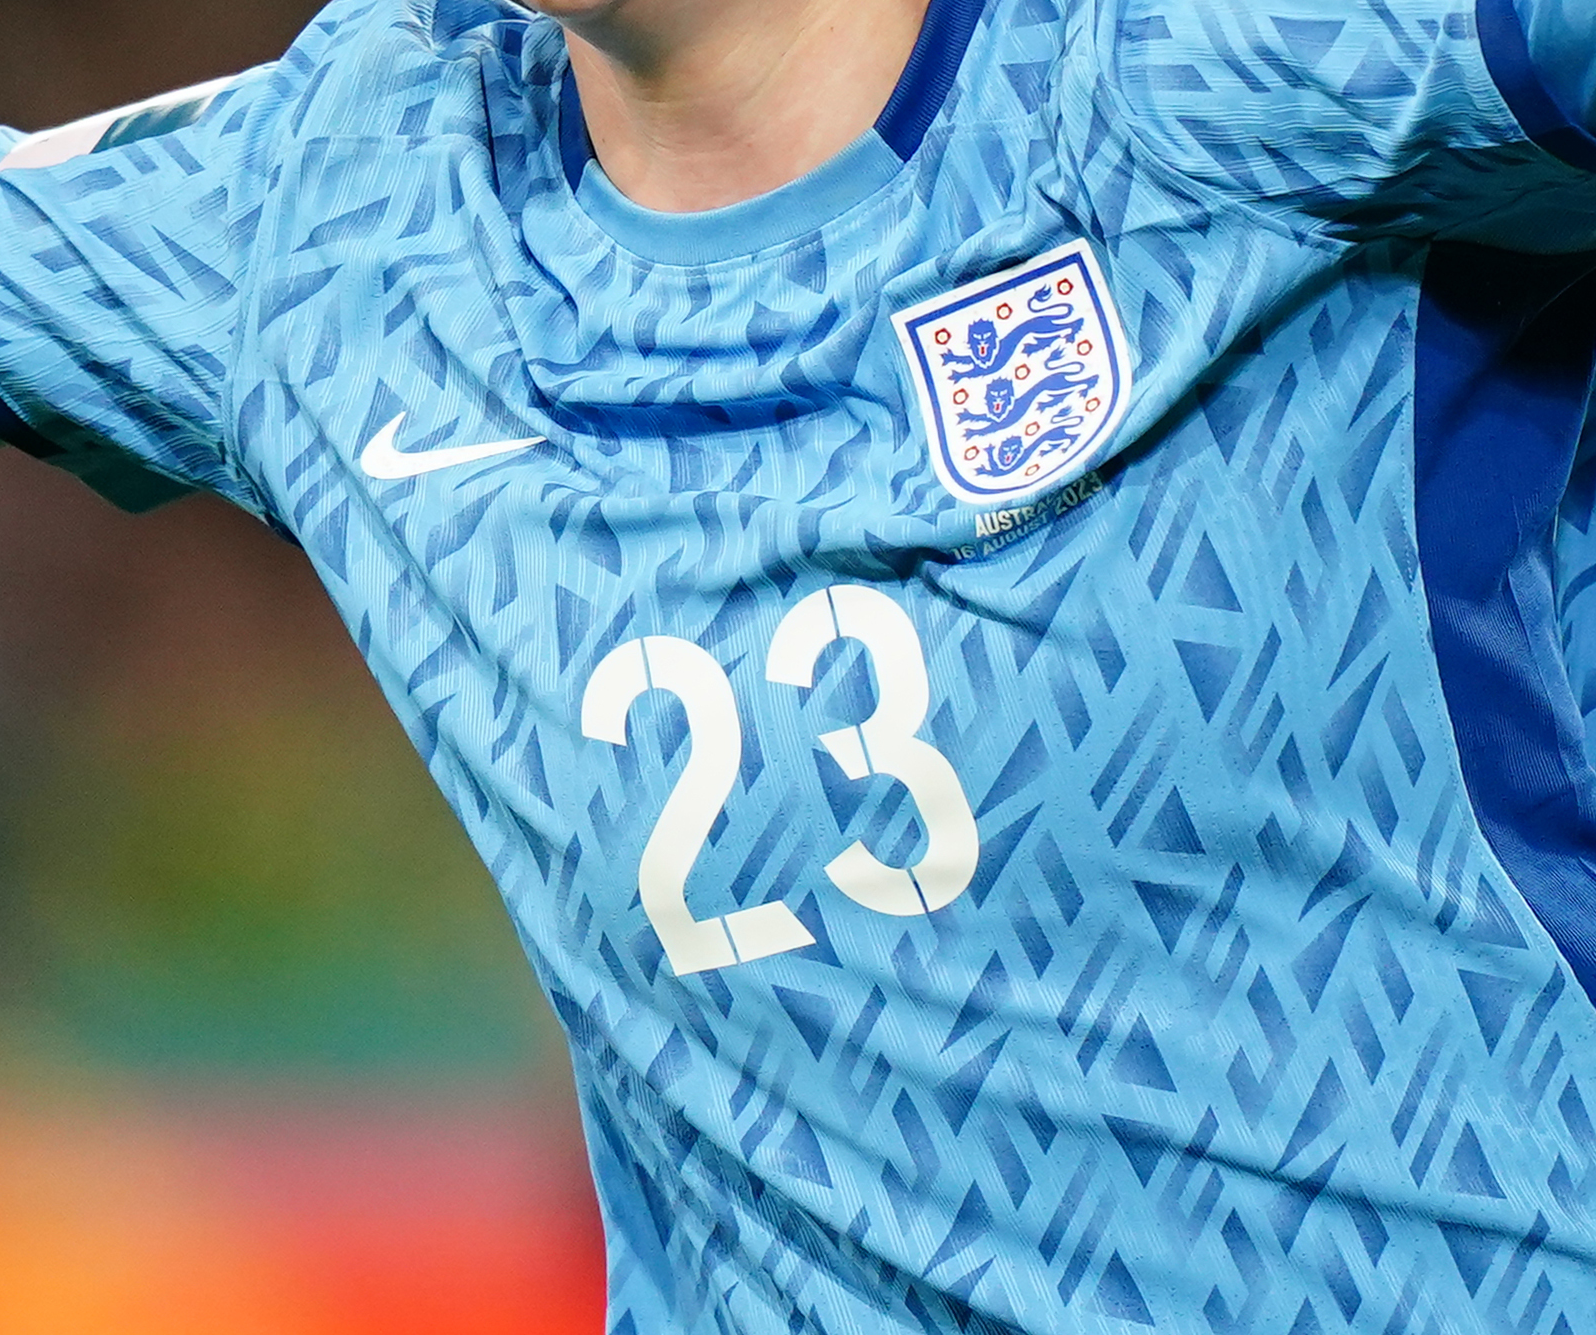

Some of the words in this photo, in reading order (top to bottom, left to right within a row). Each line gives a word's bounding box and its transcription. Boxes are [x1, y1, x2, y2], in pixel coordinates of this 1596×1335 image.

[953, 544, 976, 560] 16
[983, 511, 1049, 556] AUGUST
[1055, 471, 1103, 515] 2023
[581, 584, 980, 977] 23
